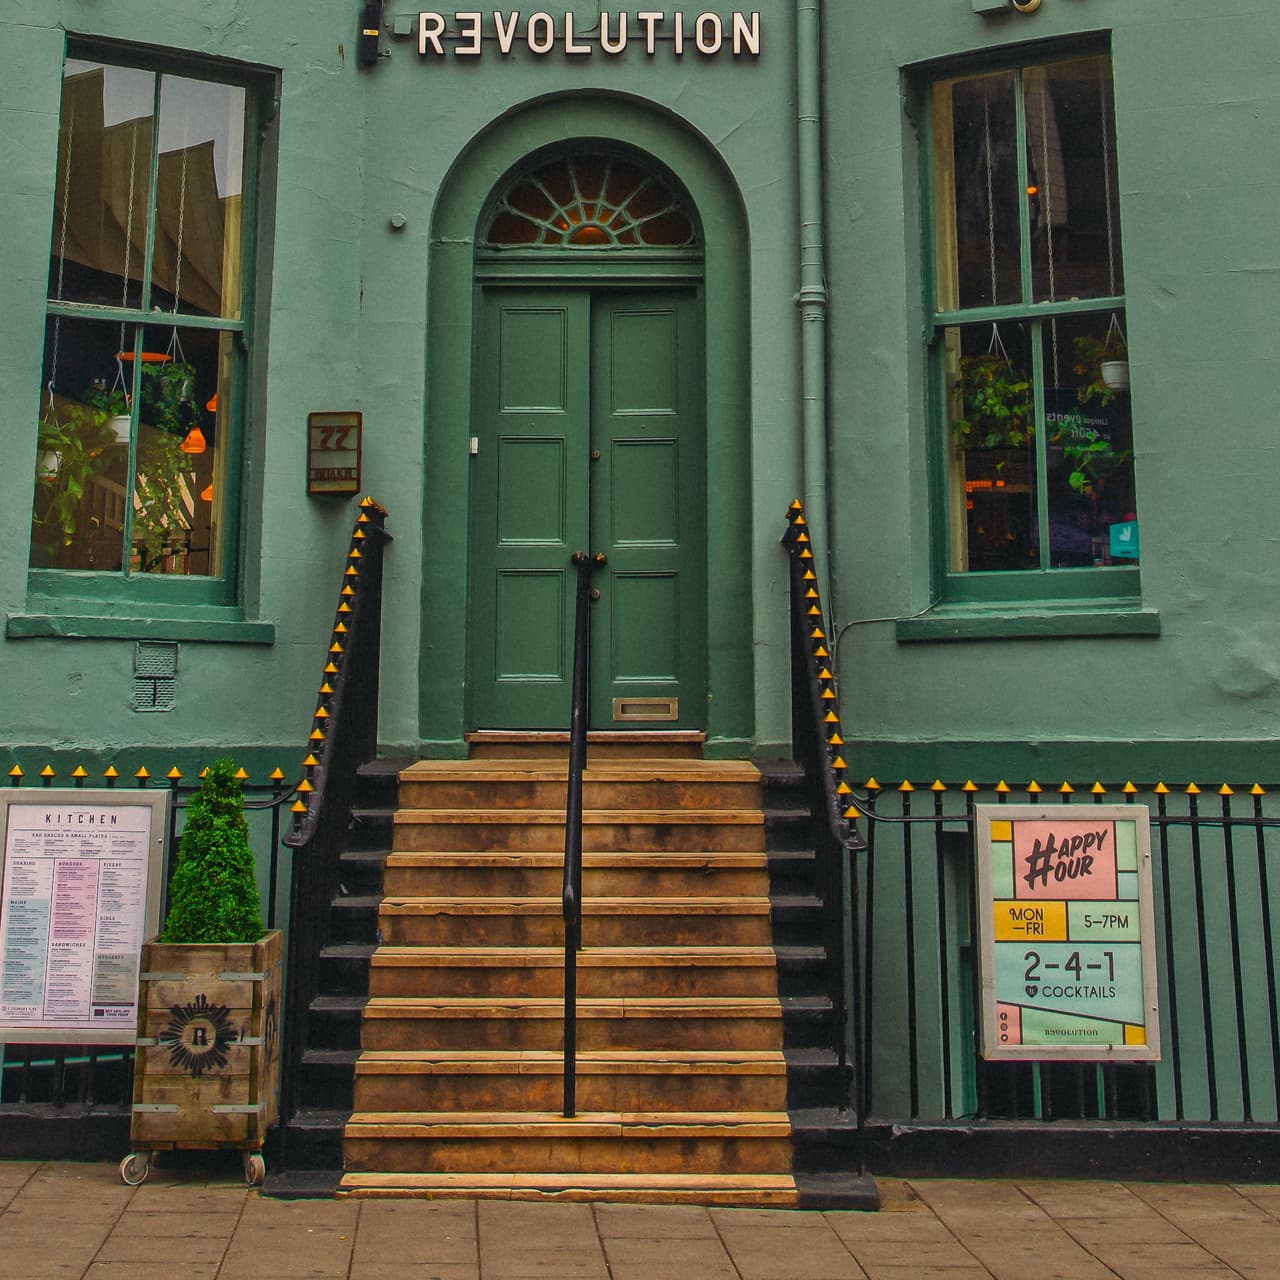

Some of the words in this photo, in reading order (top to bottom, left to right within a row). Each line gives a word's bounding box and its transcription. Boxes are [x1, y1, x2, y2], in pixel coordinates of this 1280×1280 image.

[45, 814, 118, 825] KITCHEN
[1009, 908, 1044, 922] MON
[1042, 985, 1117, 999] COCKTAILS
